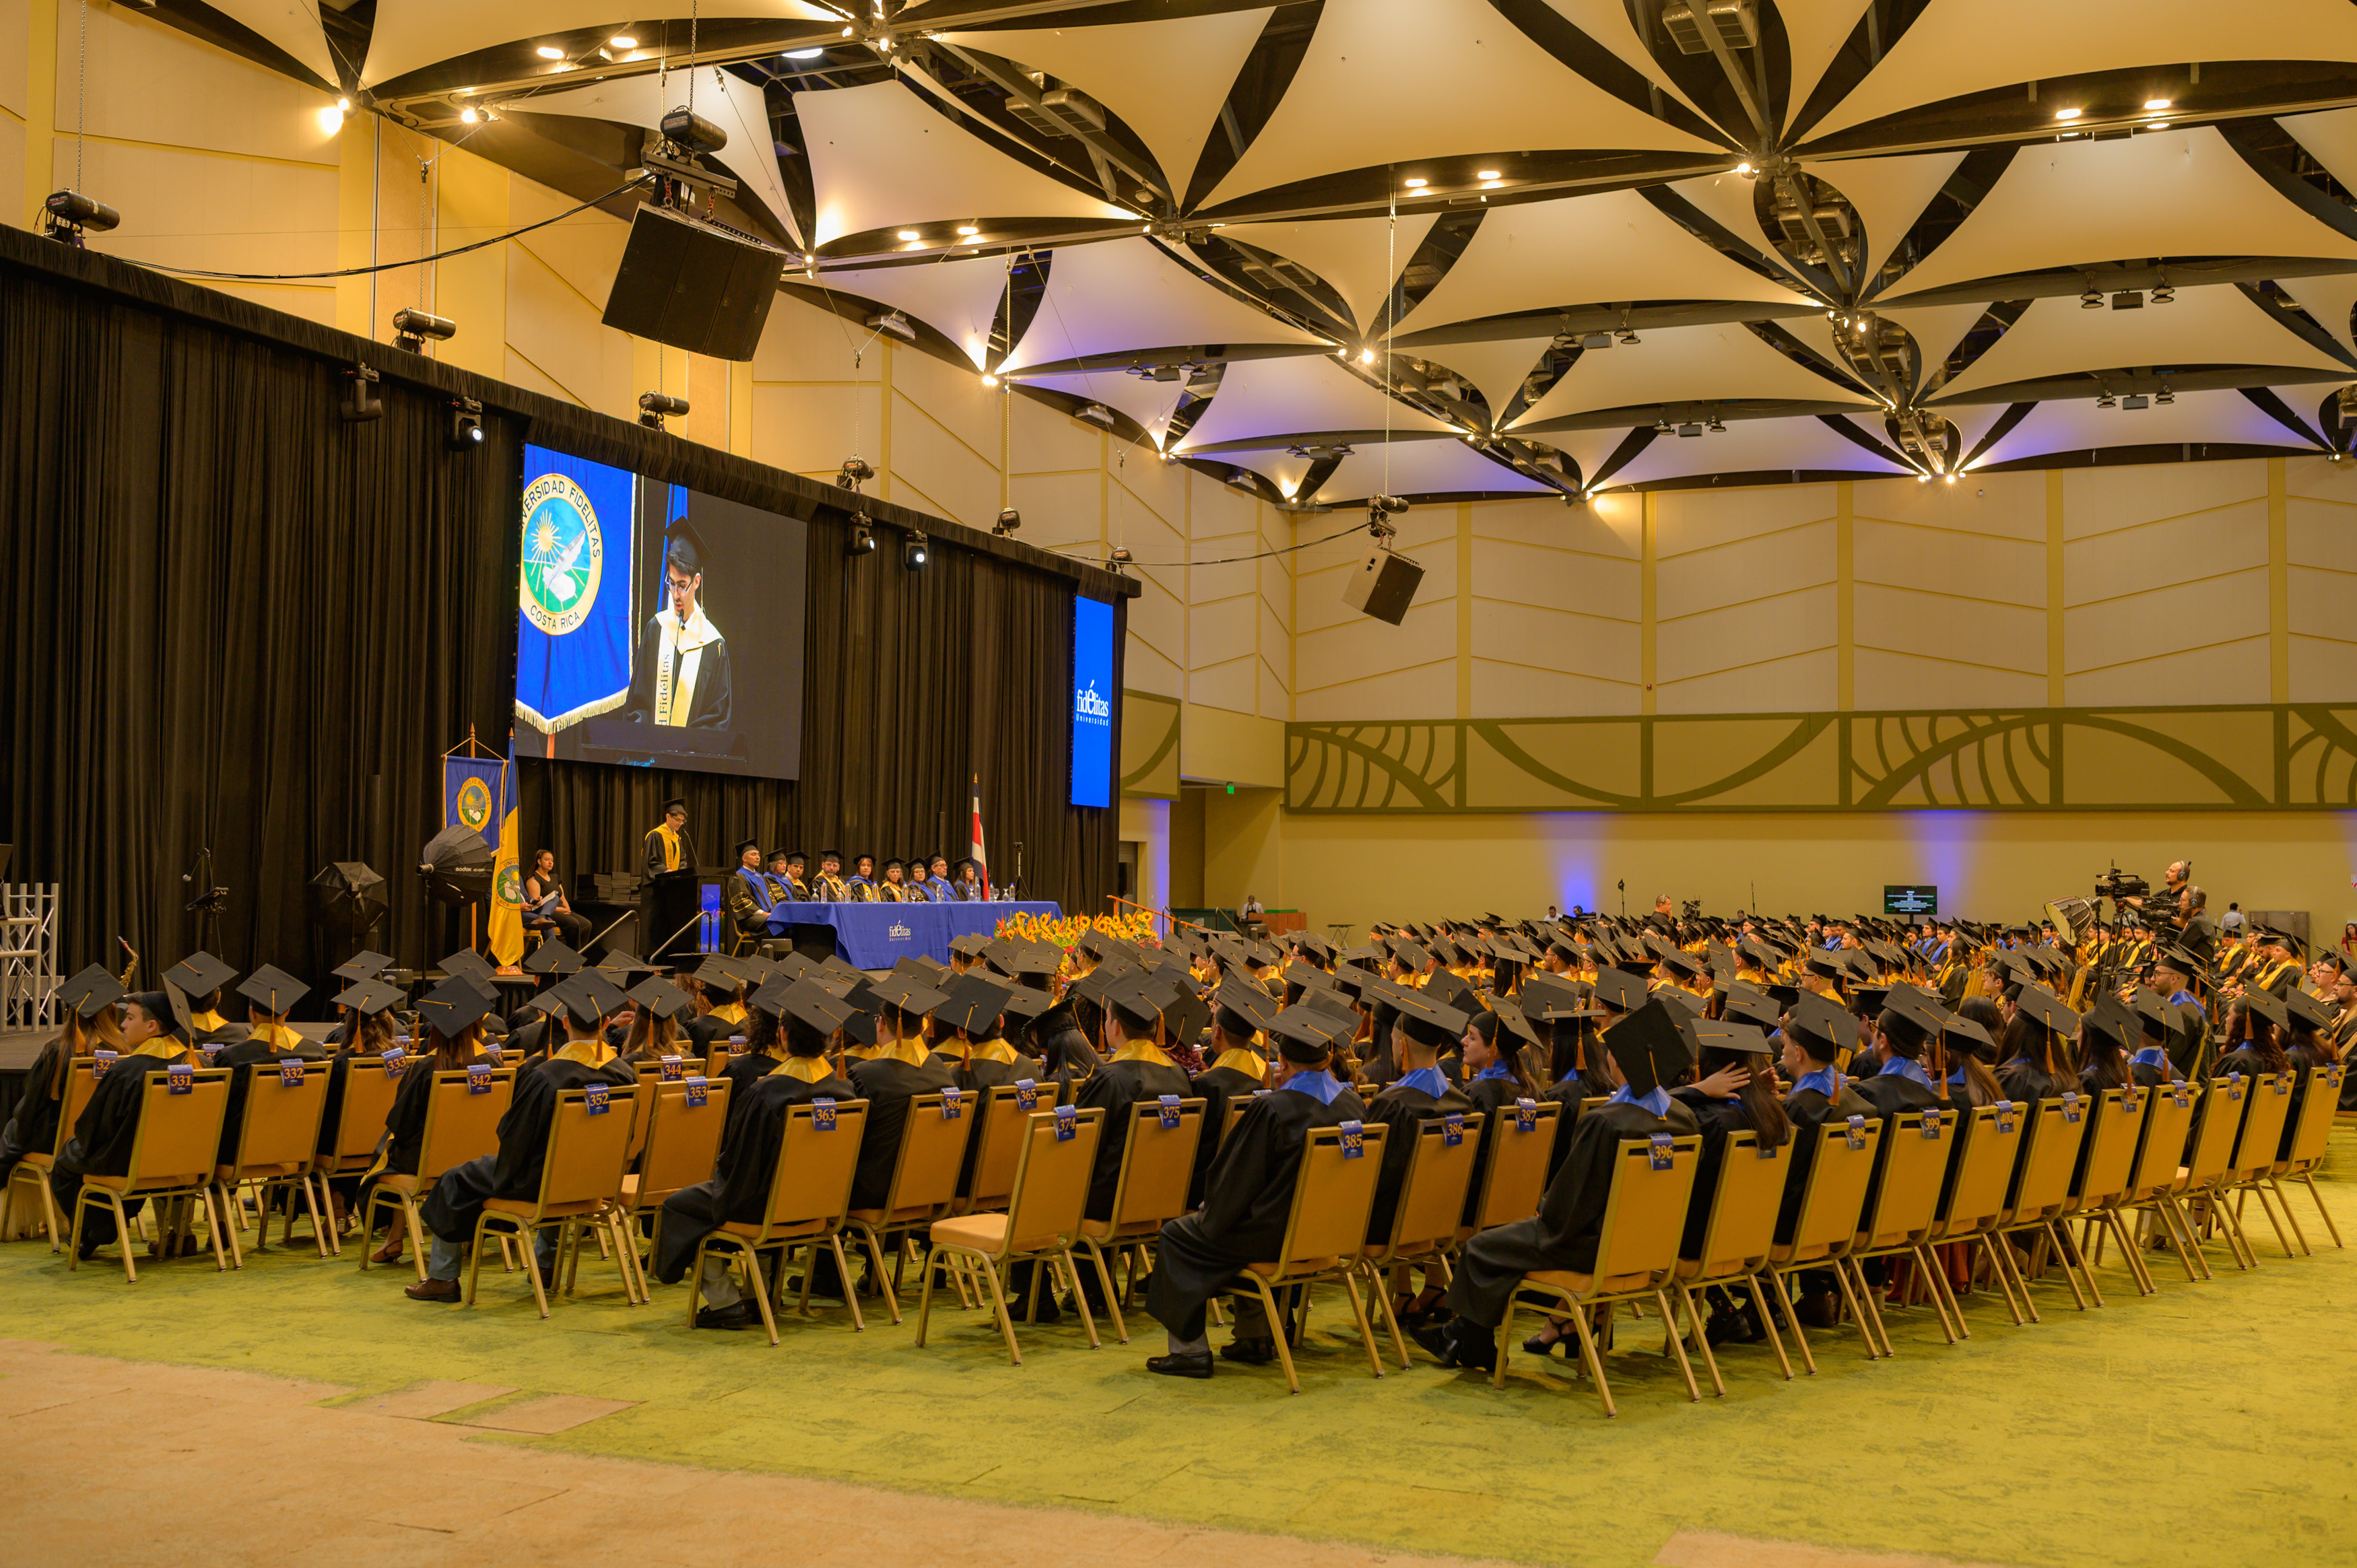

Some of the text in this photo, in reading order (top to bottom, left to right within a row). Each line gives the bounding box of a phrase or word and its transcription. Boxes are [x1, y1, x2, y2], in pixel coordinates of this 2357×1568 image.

[522, 480, 601, 558] VERSIDAD FIDELITAS
[530, 605, 580, 629] COSTA RICA
[659, 654, 669, 714] Fidélitas
[1076, 679, 1109, 718] fidélitas
[1076, 713, 1109, 726] Universidad
[459, 779, 491, 805] UNIVERSIDAD FIDELITAS
[499, 899, 509, 908] RICA
[889, 919, 911, 936] fidélitas
[387, 1056, 407, 1072] 333
[664, 1064, 682, 1076] 344
[284, 1067, 303, 1079] 332
[170, 1075, 192, 1087] 331
[471, 1074, 491, 1087] 342
[688, 1085, 707, 1098] 353
[1020, 1088, 1036, 1102] 365
[2178, 1089, 2188, 1100] 403
[589, 1092, 609, 1107] 352
[945, 1097, 961, 1110] 364
[816, 1108, 836, 1122] 363
[1163, 1105, 1180, 1119] 375
[2068, 1102, 2080, 1114] 401
[1520, 1109, 1537, 1122] 387
[2000, 1111, 2013, 1124] 400
[1059, 1116, 1076, 1132] 374
[1447, 1122, 1463, 1136] 386
[1925, 1117, 1940, 1130] 399
[1851, 1126, 1865, 1141] 398
[1344, 1133, 1362, 1149] 385
[1654, 1145, 1673, 1160] 396
